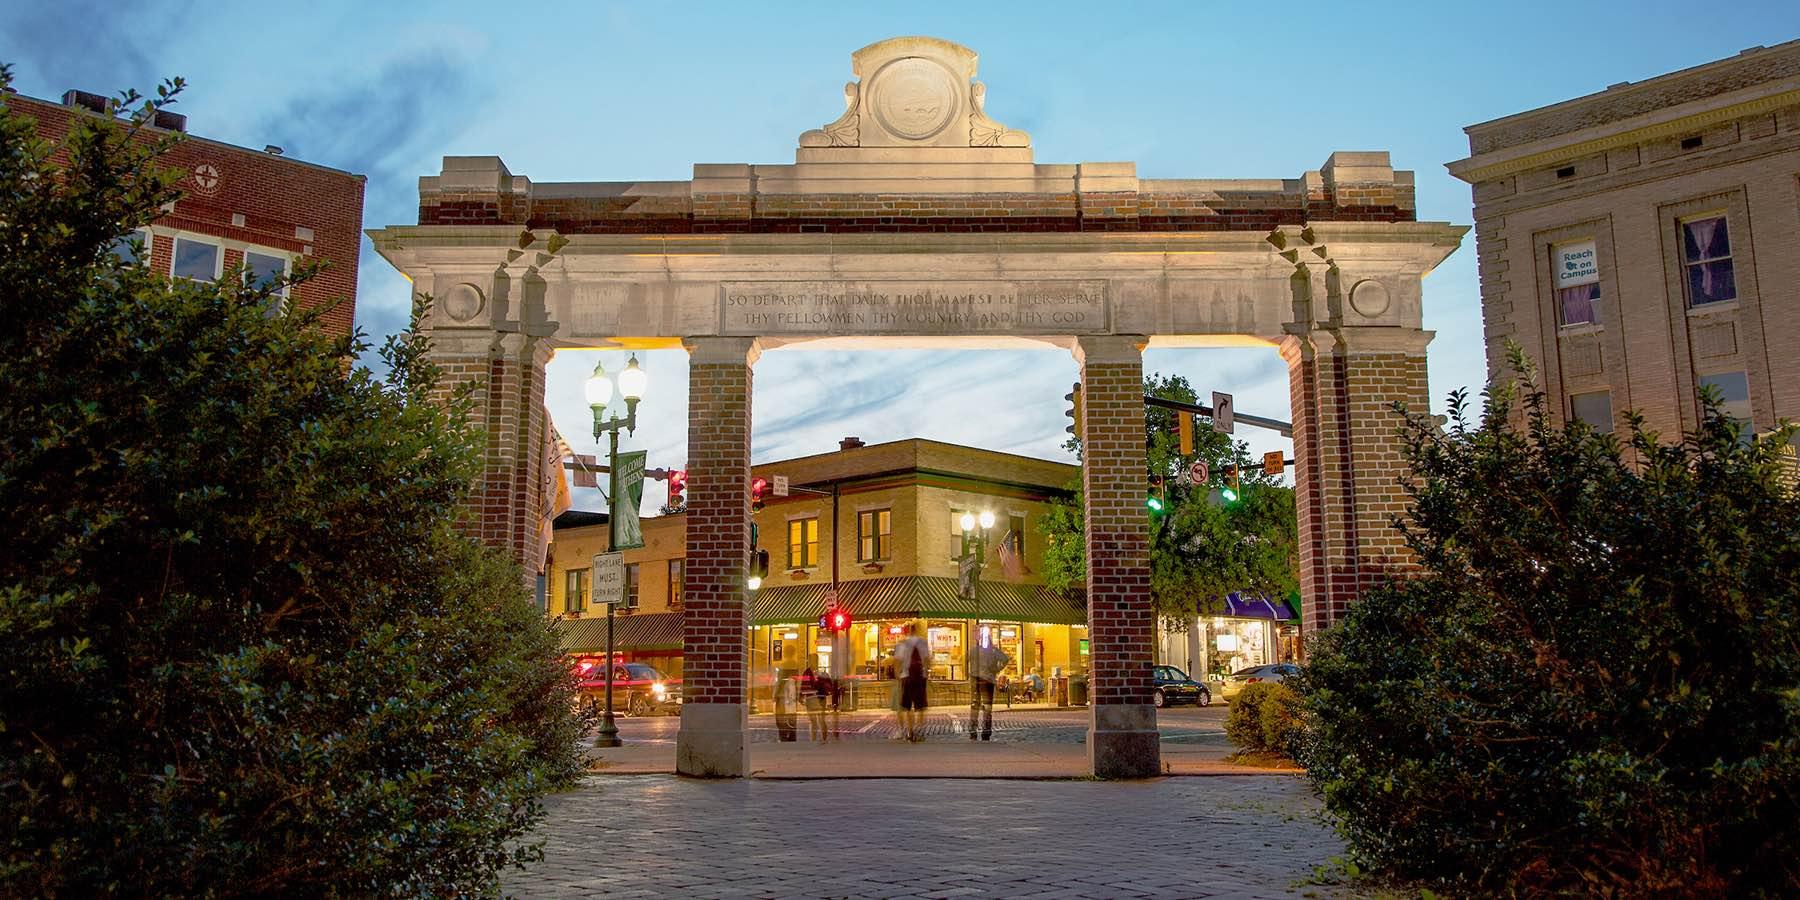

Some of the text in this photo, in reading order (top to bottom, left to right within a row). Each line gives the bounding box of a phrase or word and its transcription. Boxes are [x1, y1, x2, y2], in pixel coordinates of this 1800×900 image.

[1564, 249, 1593, 261] Reach
[1580, 261, 1592, 269] on
[1560, 268, 1597, 280] Campus
[728, 294, 747, 306] SO
[753, 294, 806, 306] DEPART
[815, 294, 845, 306] THAT
[852, 294, 889, 305] DAILY
[896, 294, 932, 305] THOU
[1000, 294, 1051, 305] BETTER
[1058, 294, 1103, 305] SERVE
[744, 311, 1085, 324] THY FELLOWMEN THY COUNTRY AND THY GOD
[600, 572, 616, 583] MUST
